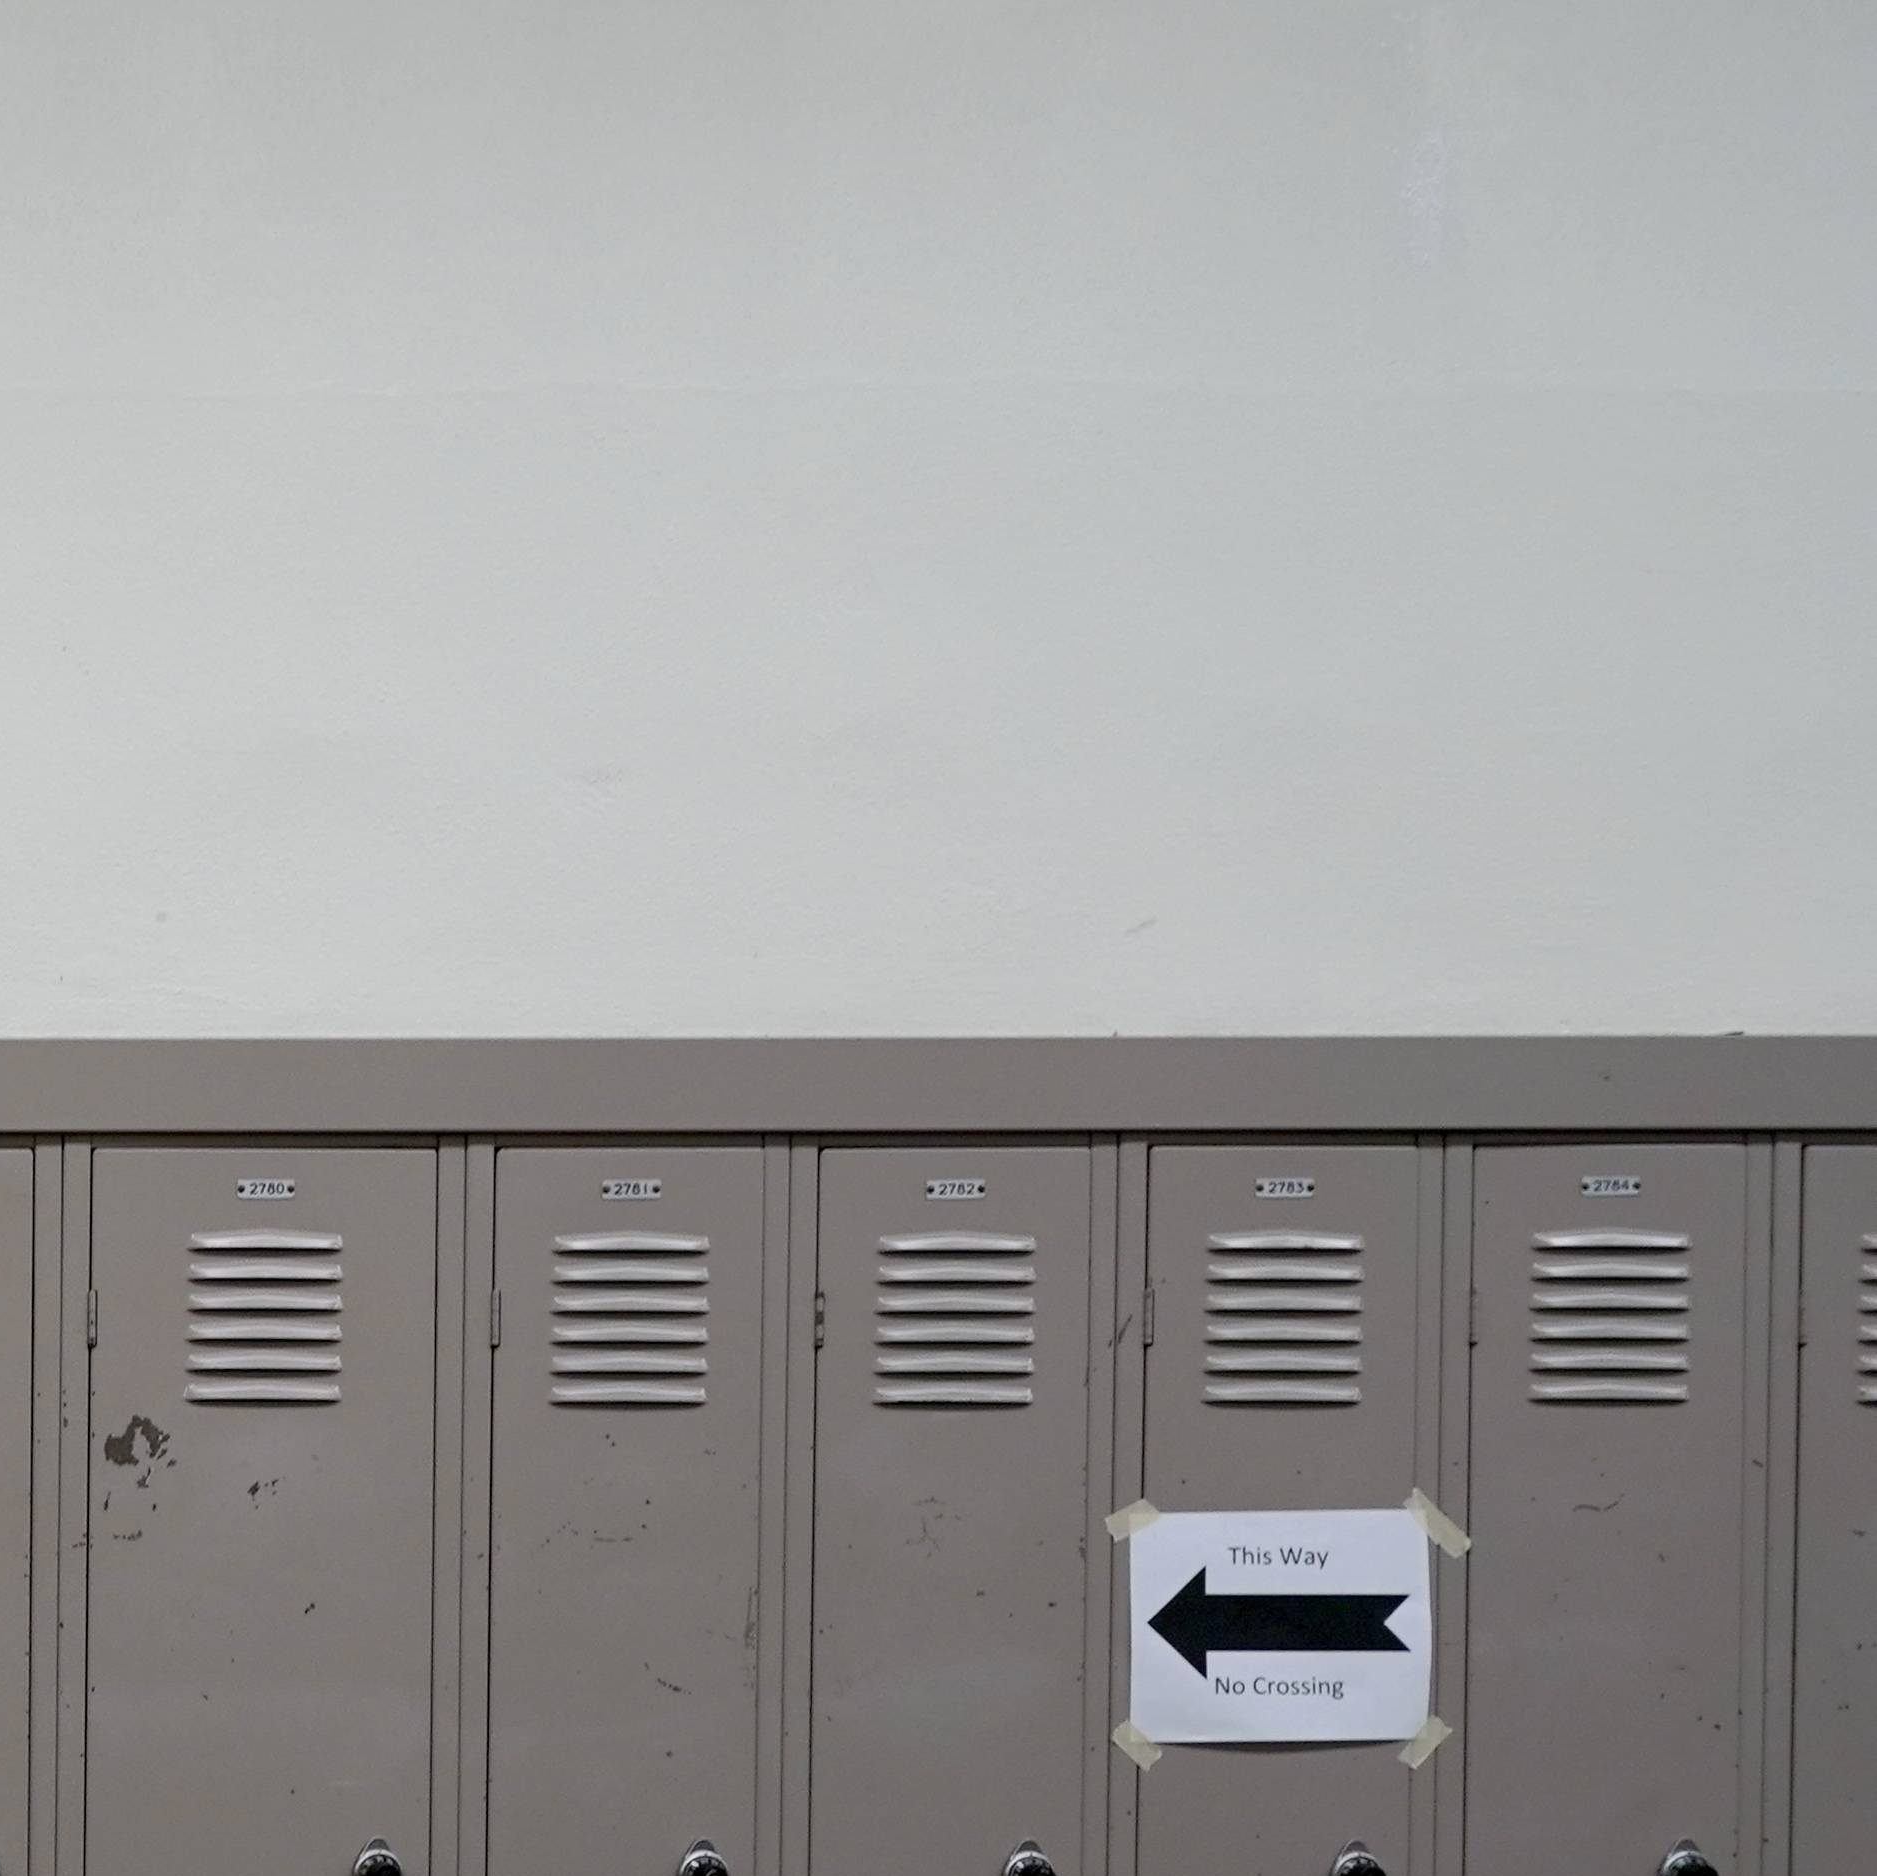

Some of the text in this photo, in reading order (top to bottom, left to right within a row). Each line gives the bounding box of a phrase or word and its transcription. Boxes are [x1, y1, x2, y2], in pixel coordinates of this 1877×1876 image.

[249, 1183, 285, 1195] 2780
[613, 1184, 649, 1195] 2781
[938, 1184, 975, 1196] 2782
[1268, 1182, 1305, 1194] 2783
[1593, 1180, 1630, 1192] 2784
[1228, 1546, 1329, 1569] This Way
[1215, 1676, 1344, 1700] No Crossing
